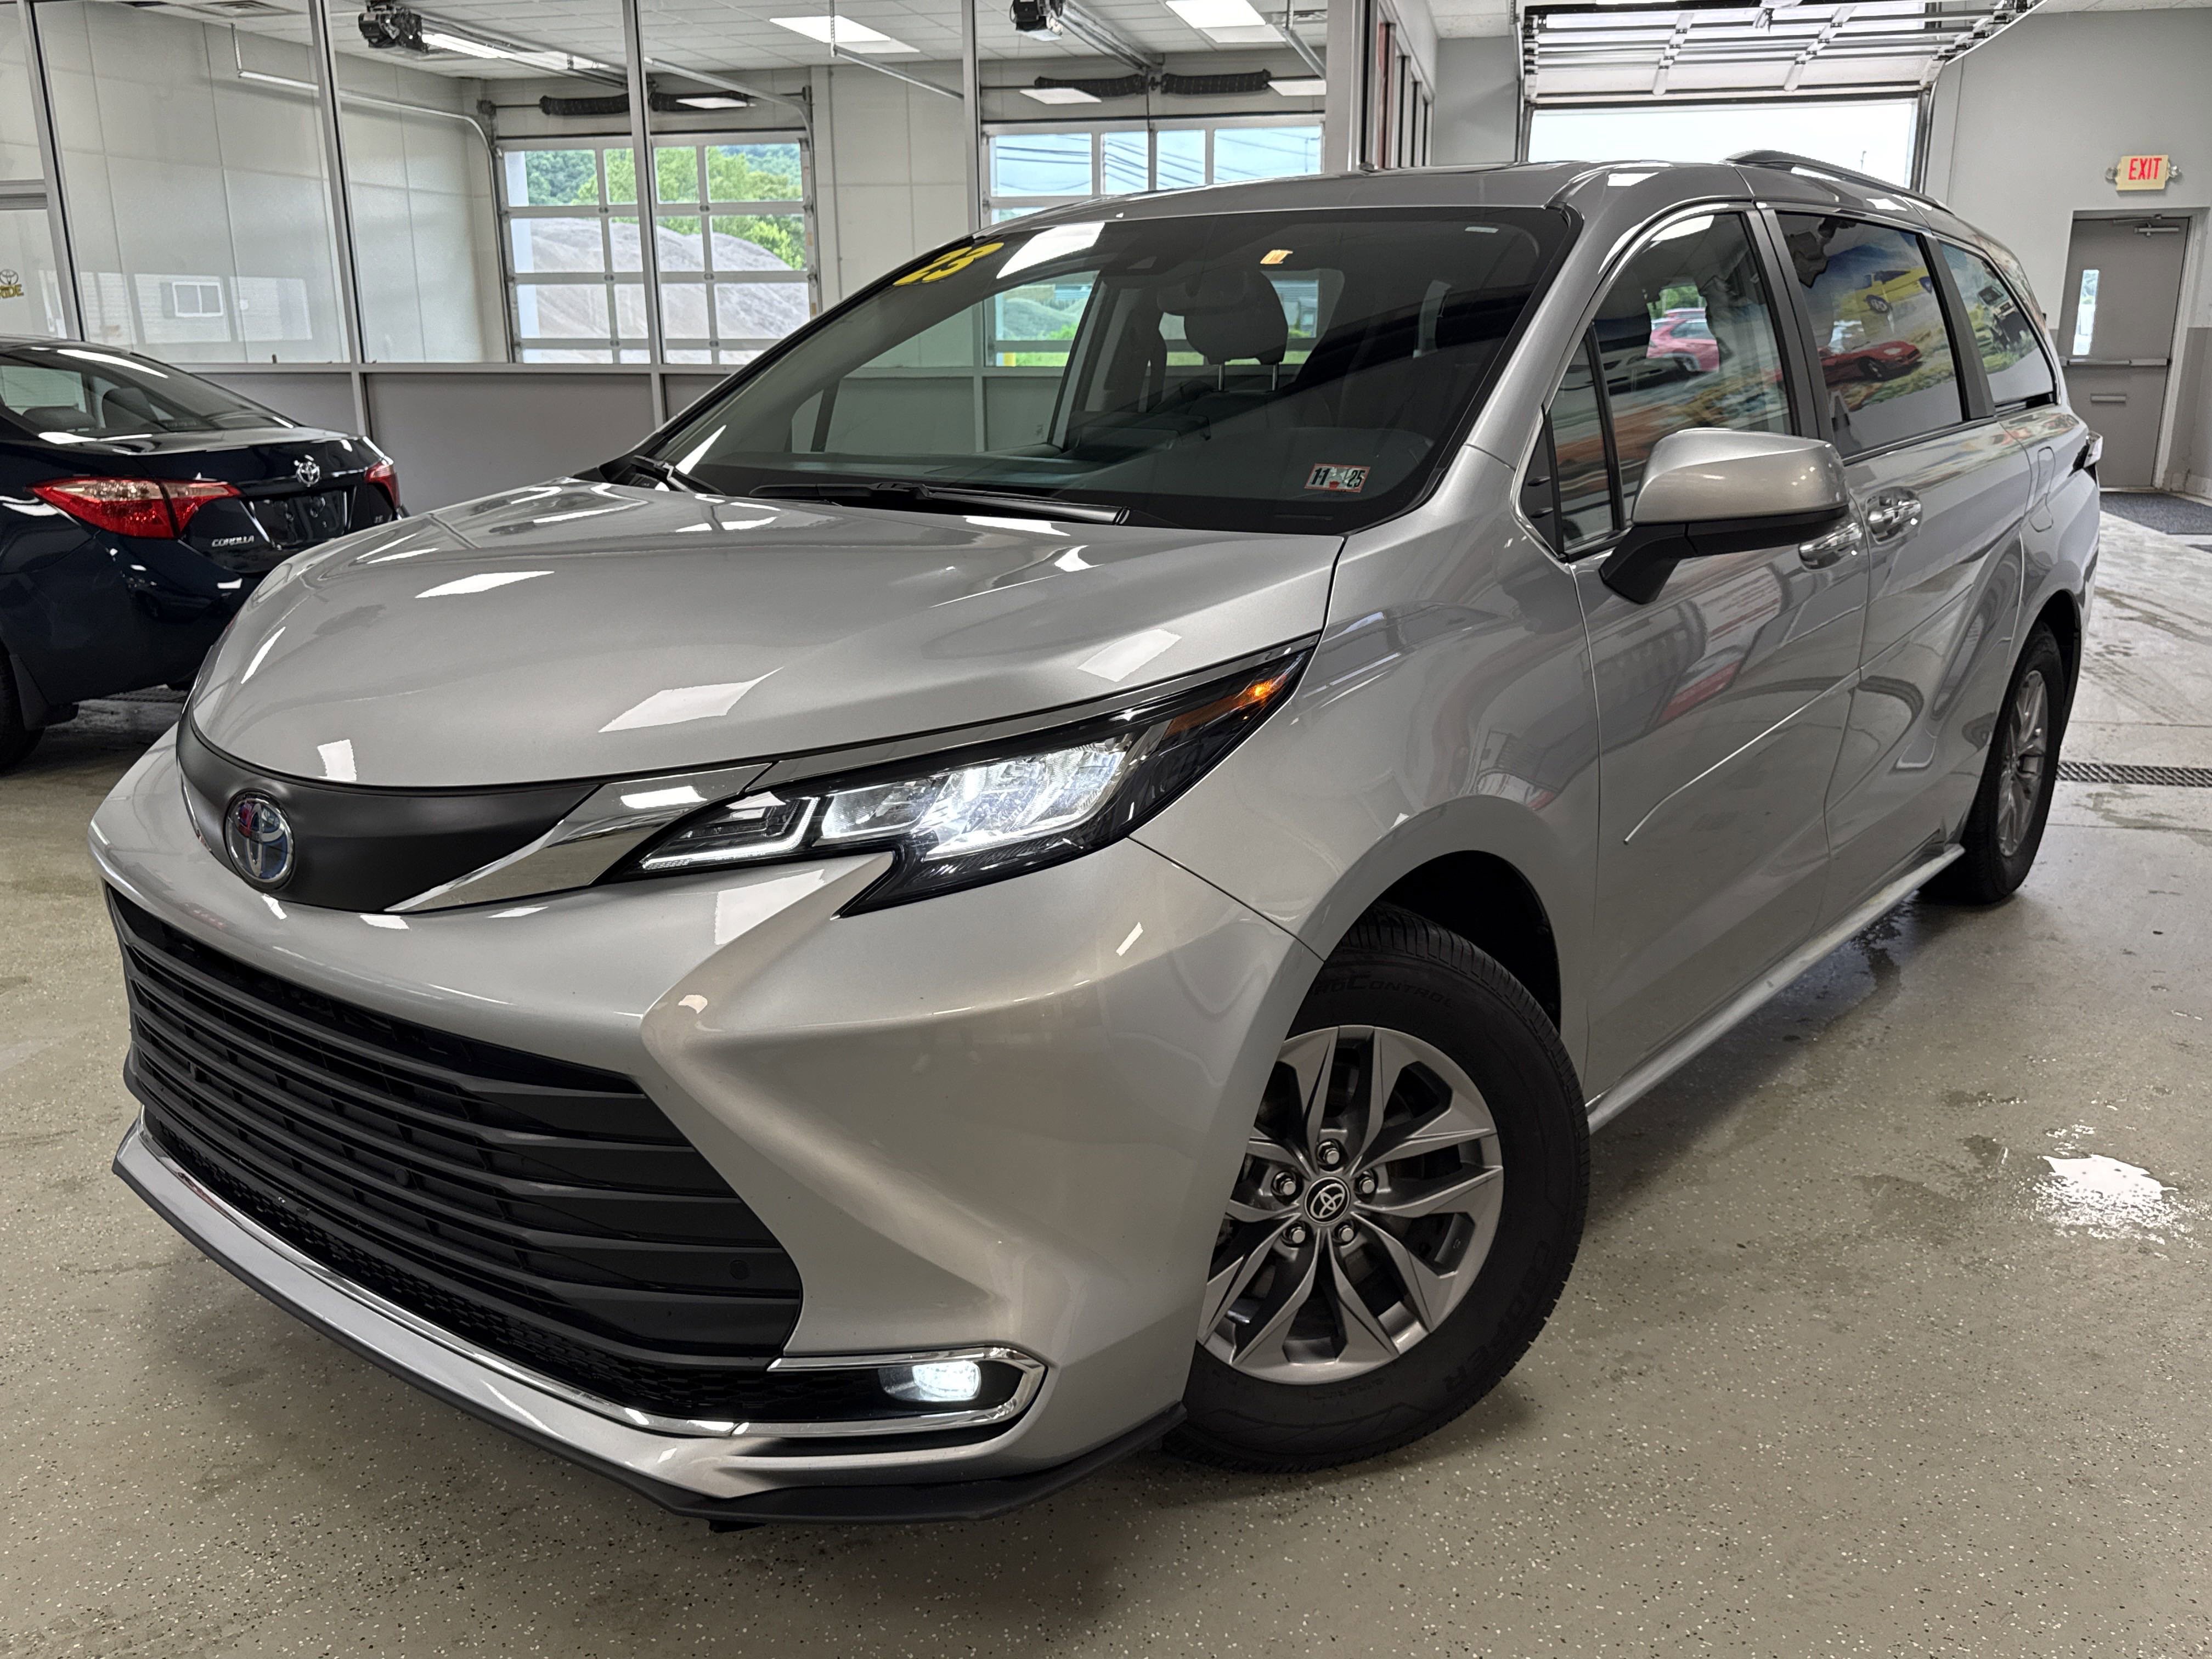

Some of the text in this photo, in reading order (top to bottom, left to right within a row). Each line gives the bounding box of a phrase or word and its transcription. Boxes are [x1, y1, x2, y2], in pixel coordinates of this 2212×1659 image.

[2128, 157, 2162, 180] EXIT
[893, 242, 1004, 286] 23
[1346, 470, 1365, 487] 25
[211, 535, 255, 548] COROLLA
